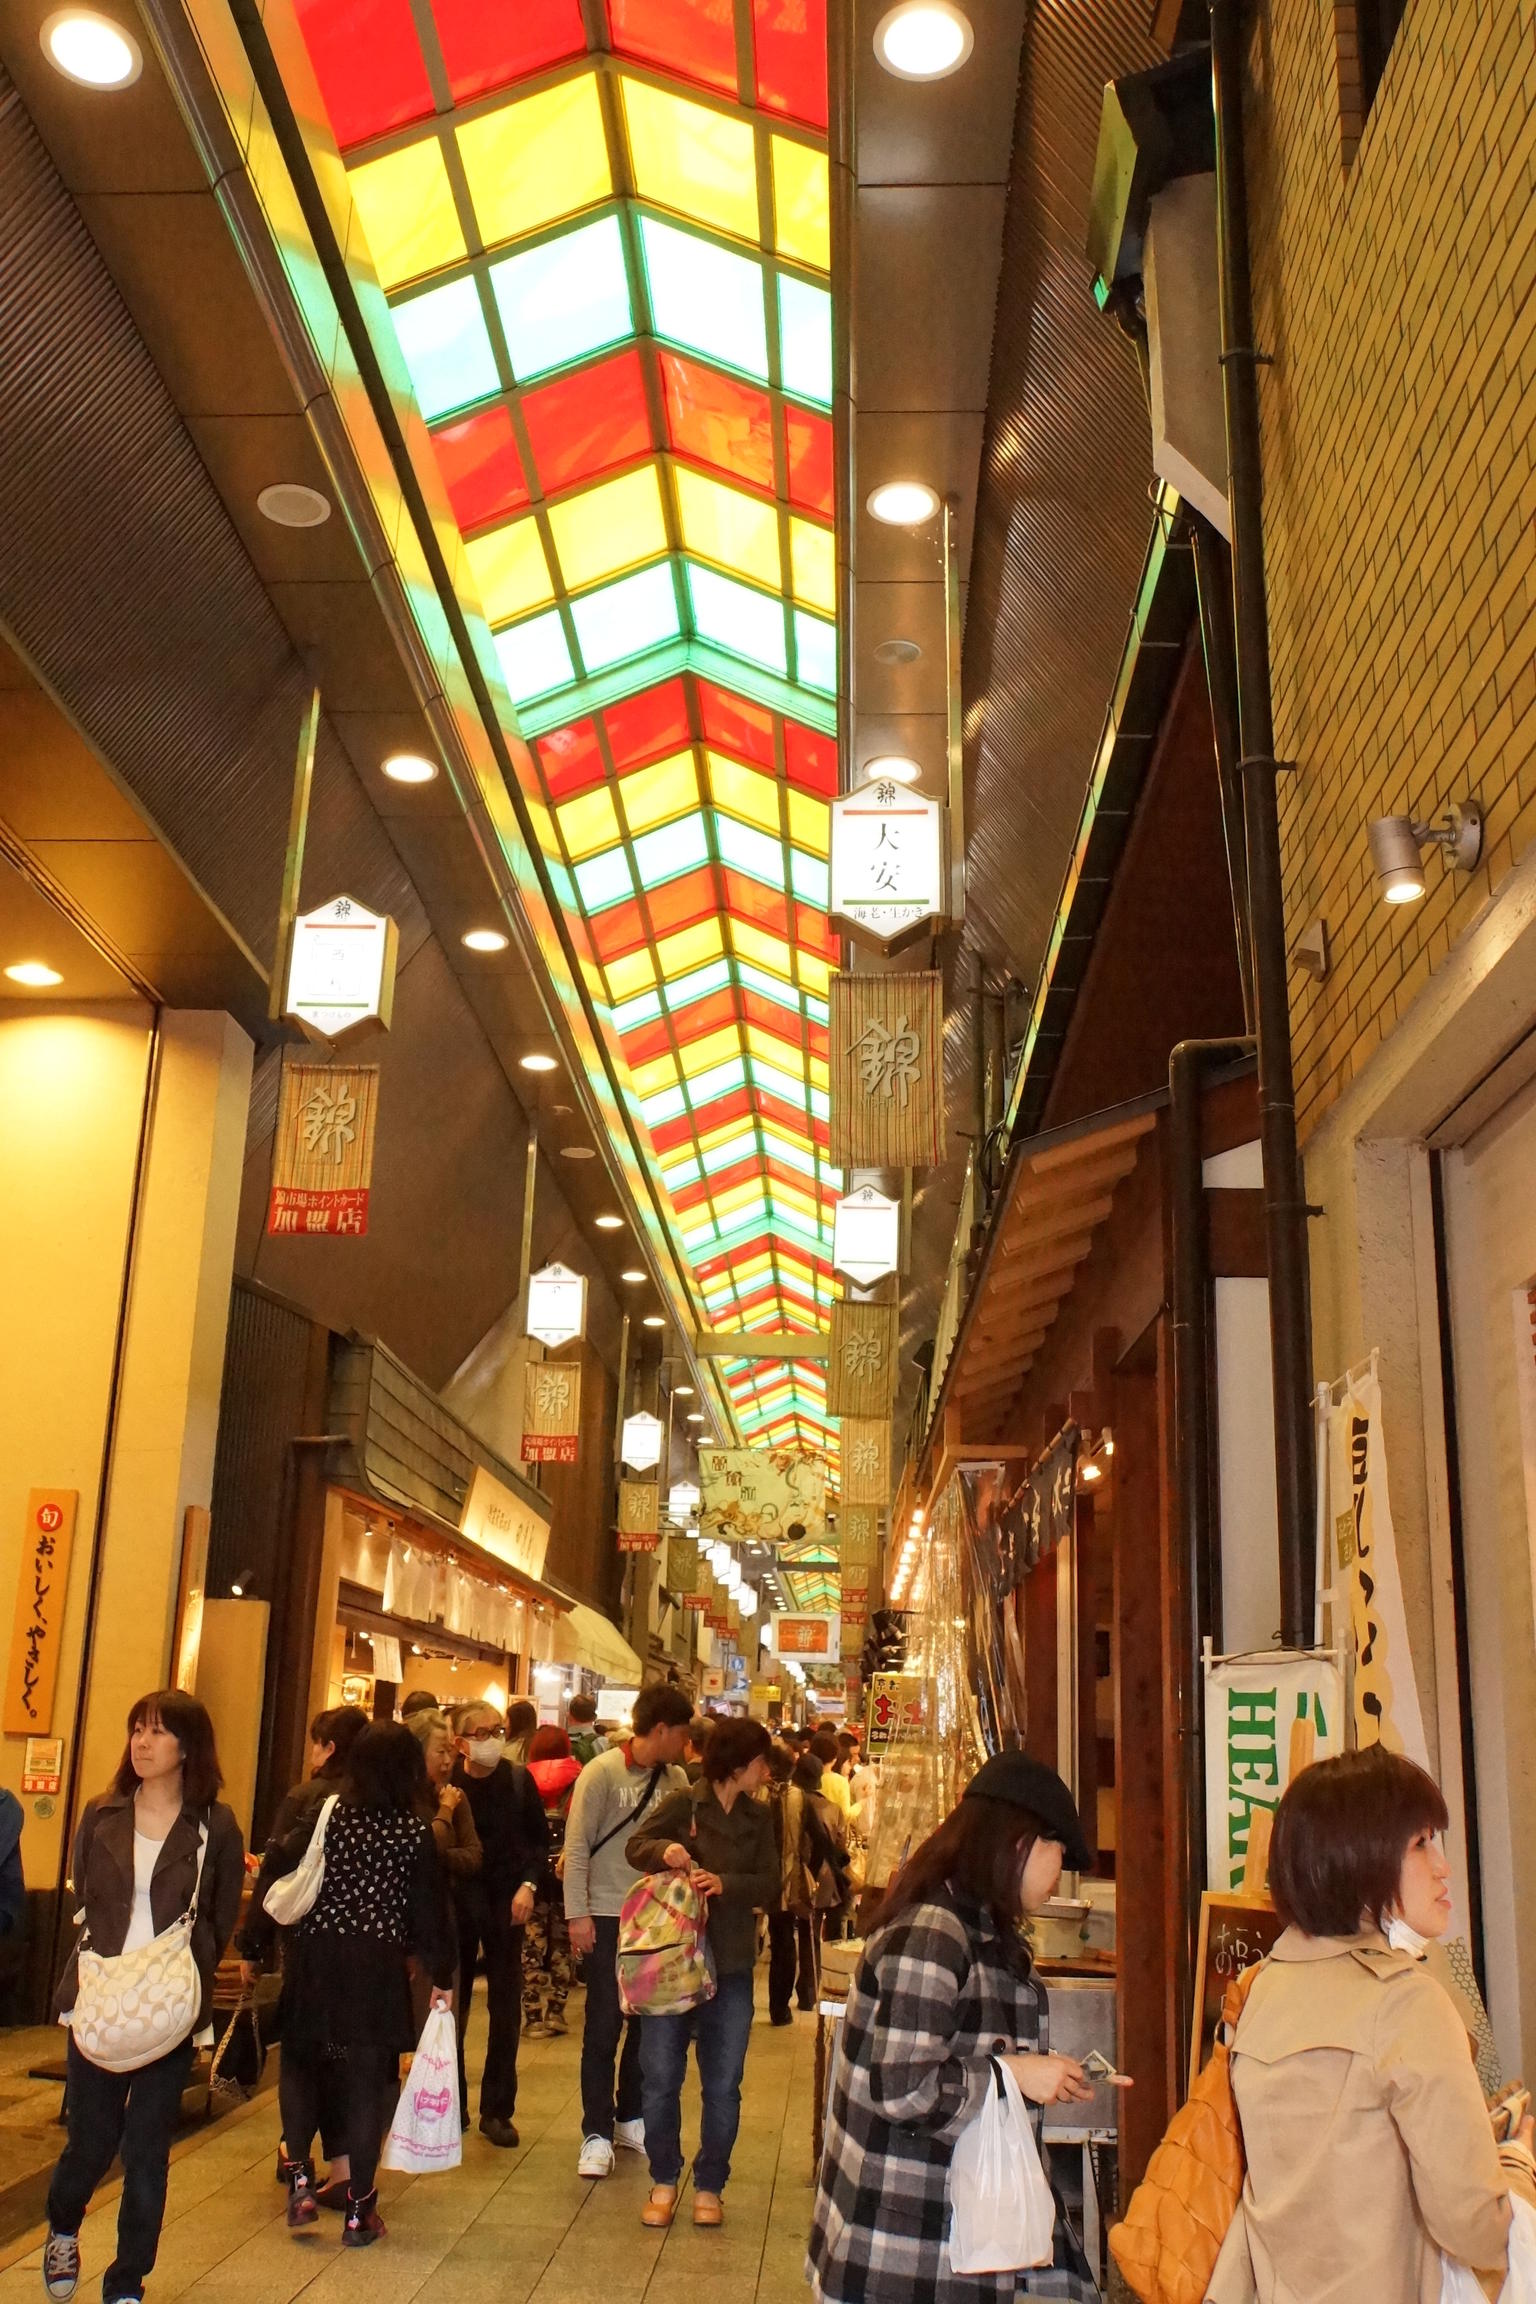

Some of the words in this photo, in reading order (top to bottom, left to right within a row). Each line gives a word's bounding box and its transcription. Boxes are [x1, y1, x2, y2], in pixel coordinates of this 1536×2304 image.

[873, 782, 896, 806] 錦
[871, 823, 900, 891] 大安
[843, 1015, 922, 1110] 錦
[293, 1084, 357, 1166] 錦
[274, 1206, 363, 1234] 加盟店
[838, 1327, 882, 1385] 錦
[533, 1374, 570, 1421] 錦
[848, 1439, 880, 1480] 錦
[40, 1508, 59, 1528] 旬
[626, 1488, 651, 1522] 錦
[22, 1535, 56, 1718] おいしく、やさしく。
